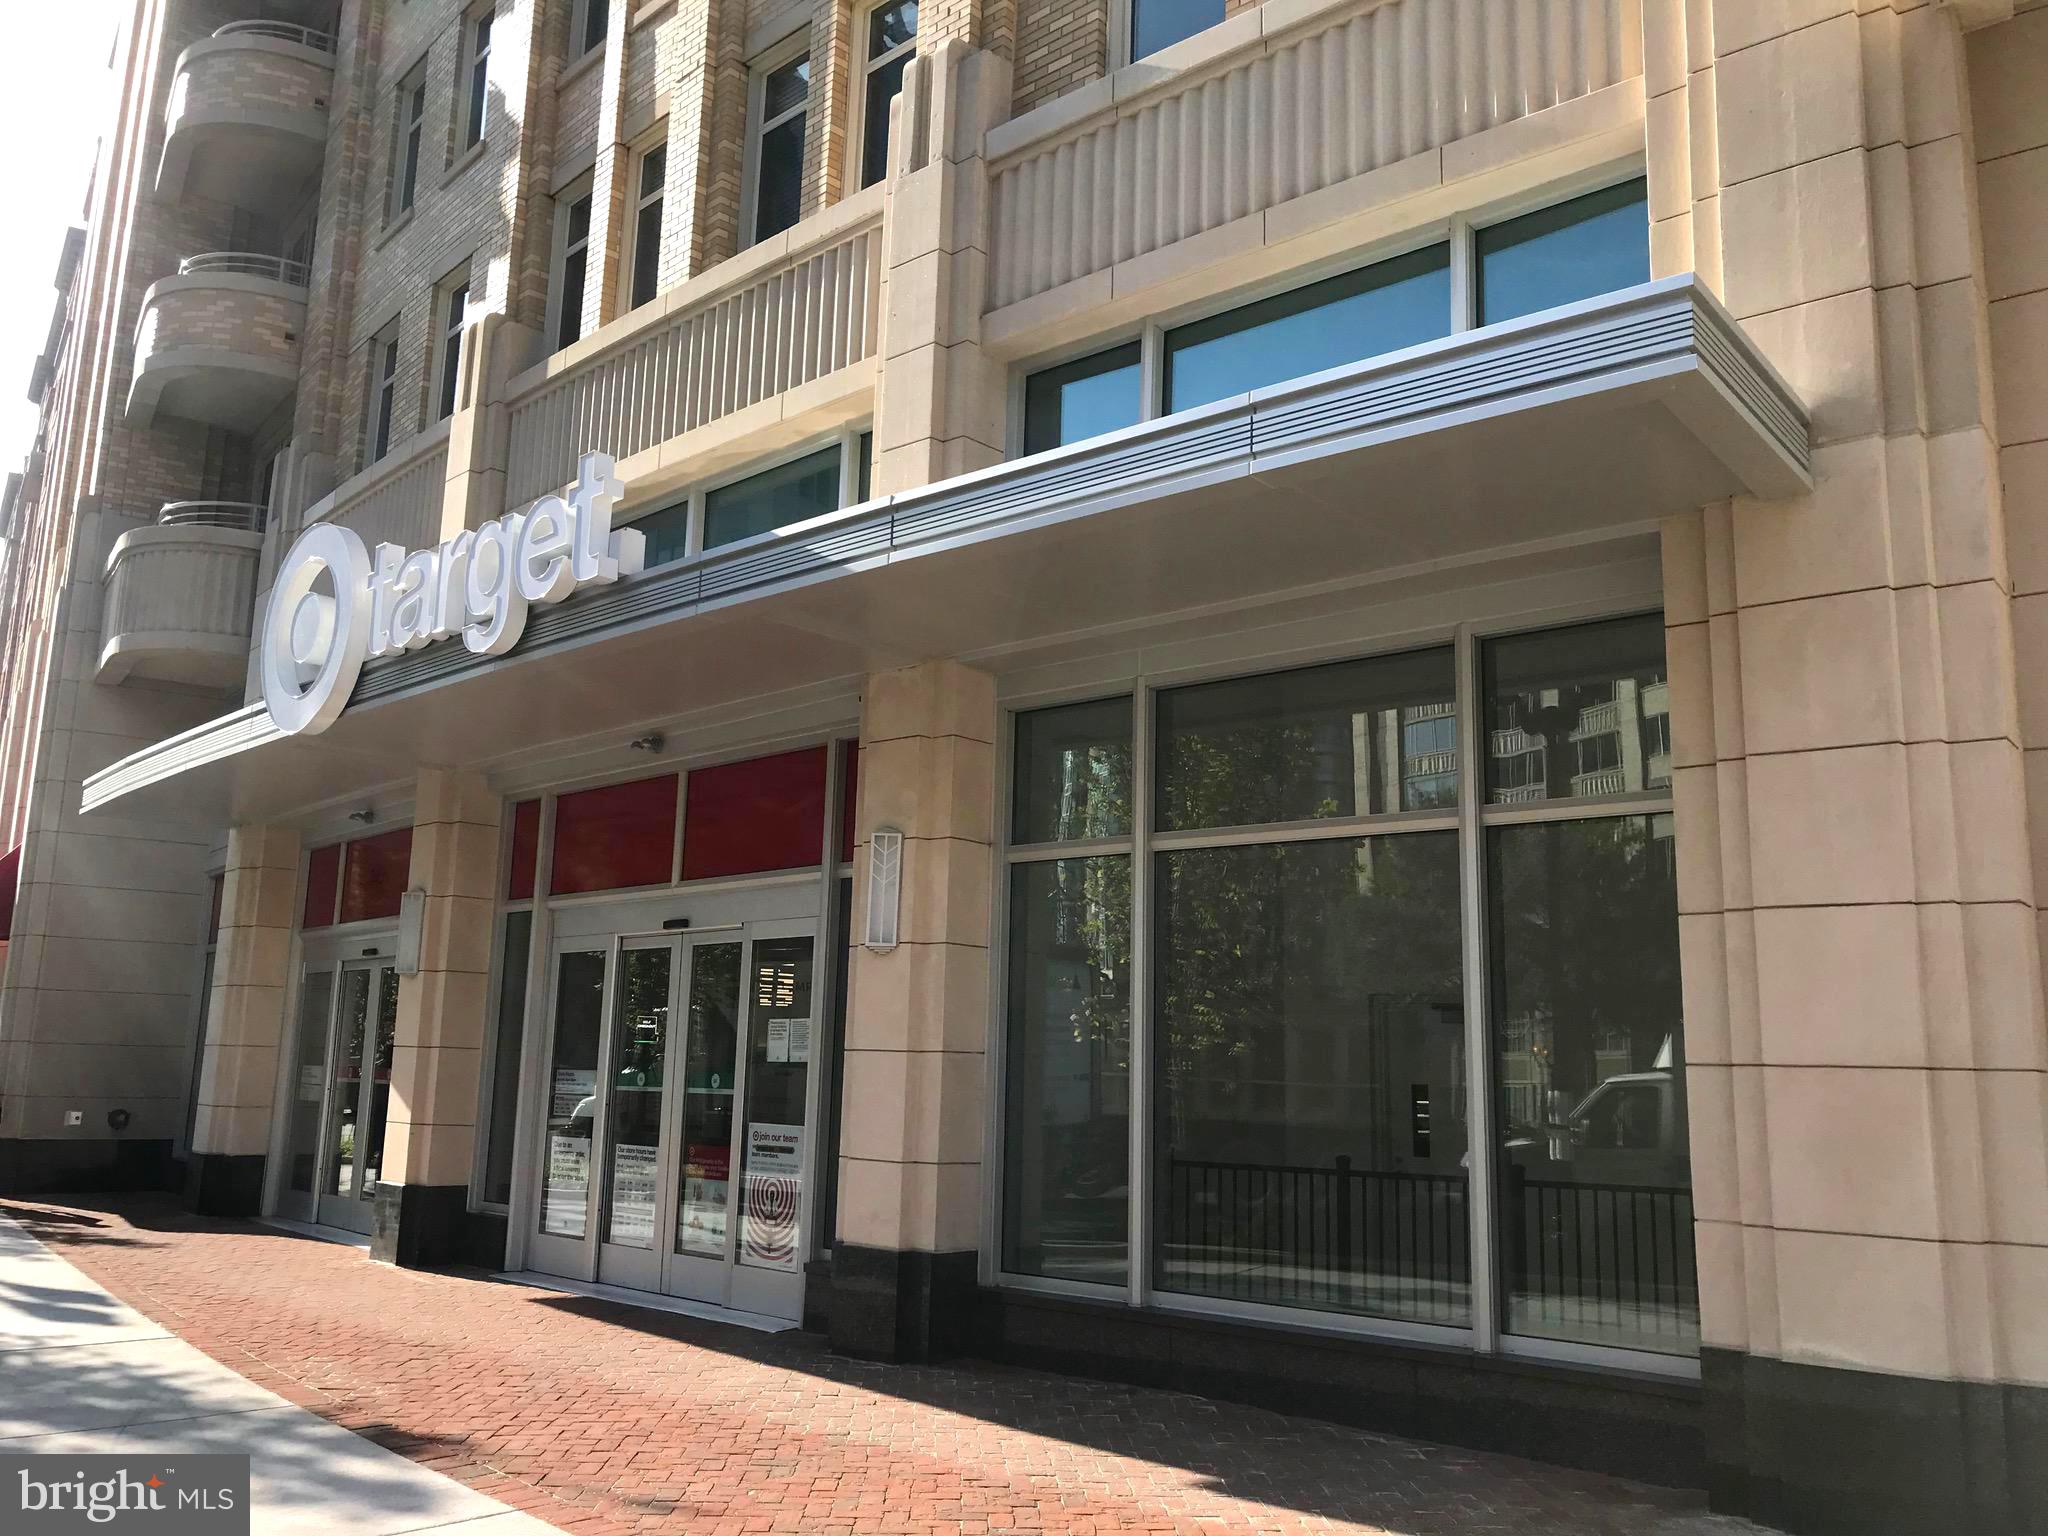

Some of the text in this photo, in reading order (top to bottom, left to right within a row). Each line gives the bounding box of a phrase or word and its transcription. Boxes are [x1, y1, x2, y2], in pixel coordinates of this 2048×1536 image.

[367, 450, 626, 655] target
[760, 1131, 799, 1144] join our team
